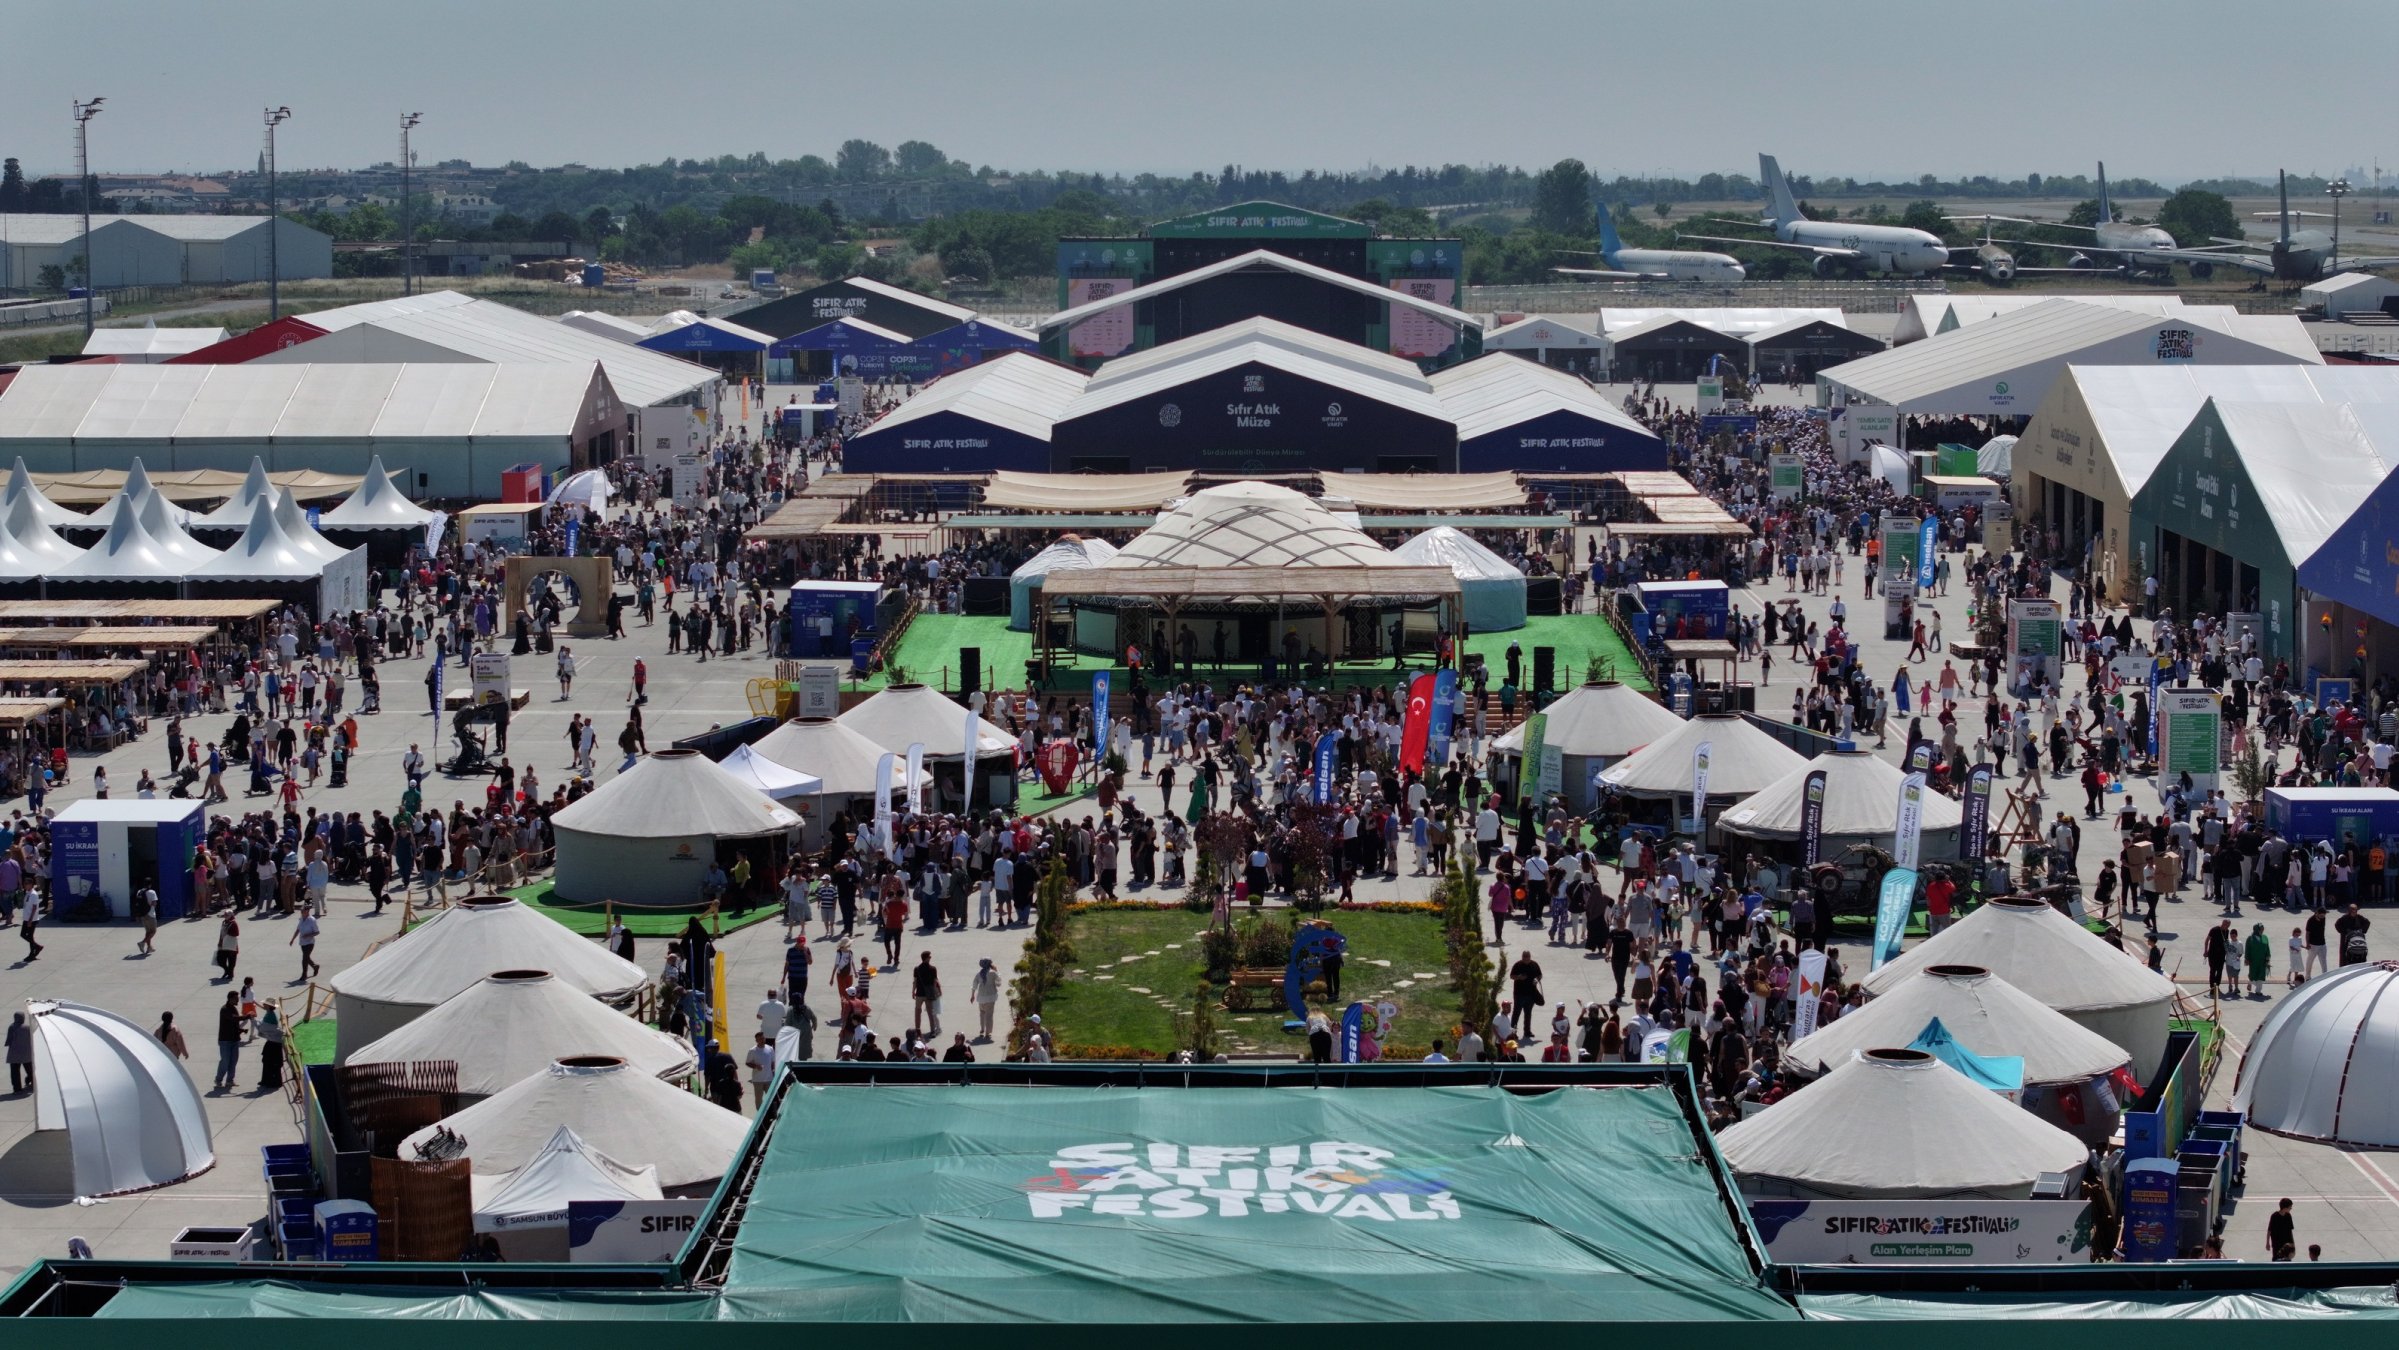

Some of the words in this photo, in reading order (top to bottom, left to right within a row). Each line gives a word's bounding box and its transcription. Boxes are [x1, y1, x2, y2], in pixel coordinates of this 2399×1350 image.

[1207, 216, 1239, 227] SIFIR
[1240, 217, 1264, 227] ATIK
[813, 298, 840, 308] SIFIR
[846, 298, 867, 308] ATIK
[2159, 330, 2188, 340] SIFIR
[2161, 340, 2184, 349] ATIK
[1227, 403, 1252, 415] Sıfır
[1255, 403, 1280, 415] Atık
[1237, 416, 1270, 427] Müze
[904, 440, 931, 448] SIFIR
[934, 439, 953, 448] ATIK
[1520, 438, 1547, 448] SIFIR
[1550, 438, 1570, 448] ATIK
[1902, 823, 1910, 839] Sıfır
[1349, 1024, 1357, 1064] san
[1049, 1142, 1395, 1170] SIFIR
[1078, 1165, 1352, 1193] ATIK
[510, 1215, 546, 1225] SAMSUN
[640, 1215, 695, 1233] SIFIR
[1824, 1216, 1879, 1234] SIFIR
[1887, 1217, 1929, 1235] ATIK
[1872, 1245, 1898, 1255] Alan
[1900, 1245, 1944, 1257] Yerleşim
[1945, 1245, 1972, 1255] Planı
